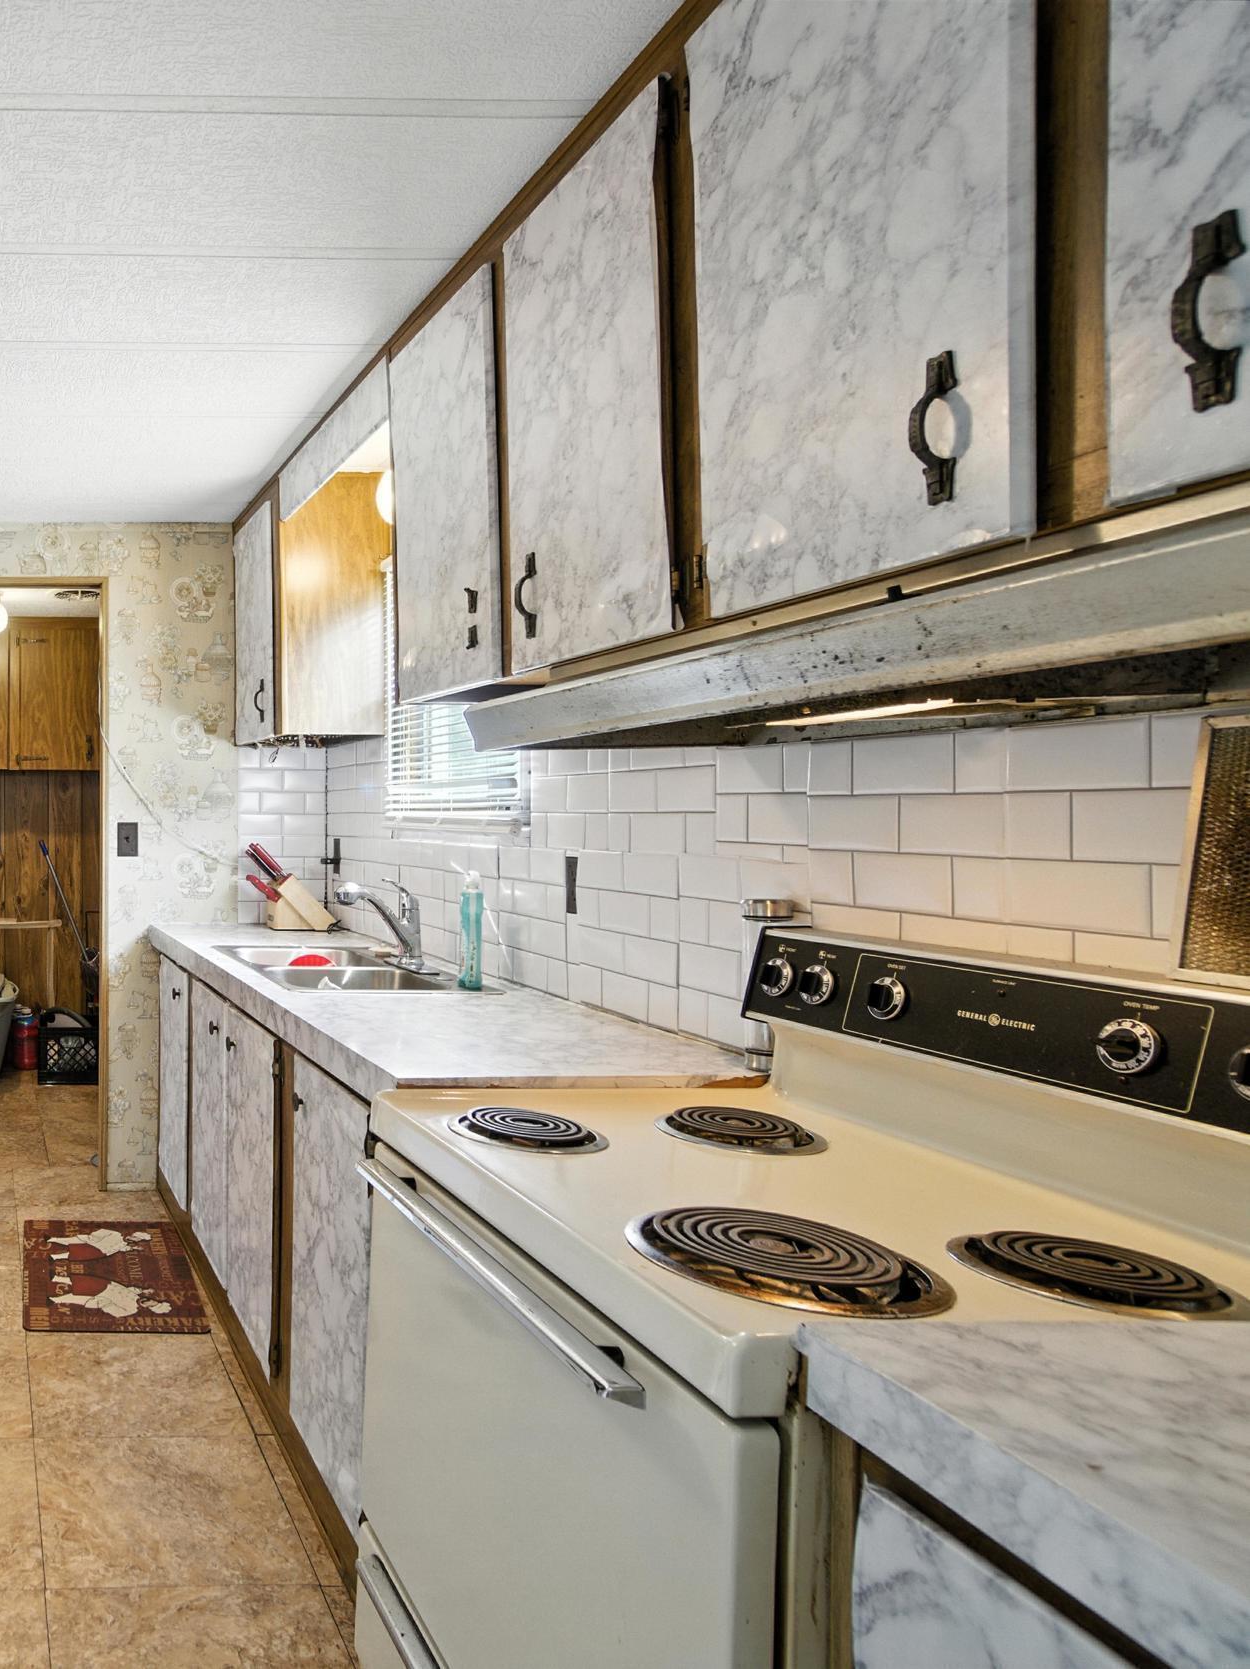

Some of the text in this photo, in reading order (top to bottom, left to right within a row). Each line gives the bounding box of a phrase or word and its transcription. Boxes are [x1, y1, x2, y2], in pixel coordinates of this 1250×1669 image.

[1123, 1001, 1141, 1009] OVEN
[957, 1009, 987, 1022] GENERAL
[1001, 1018, 1036, 1031] ELECTRIC
